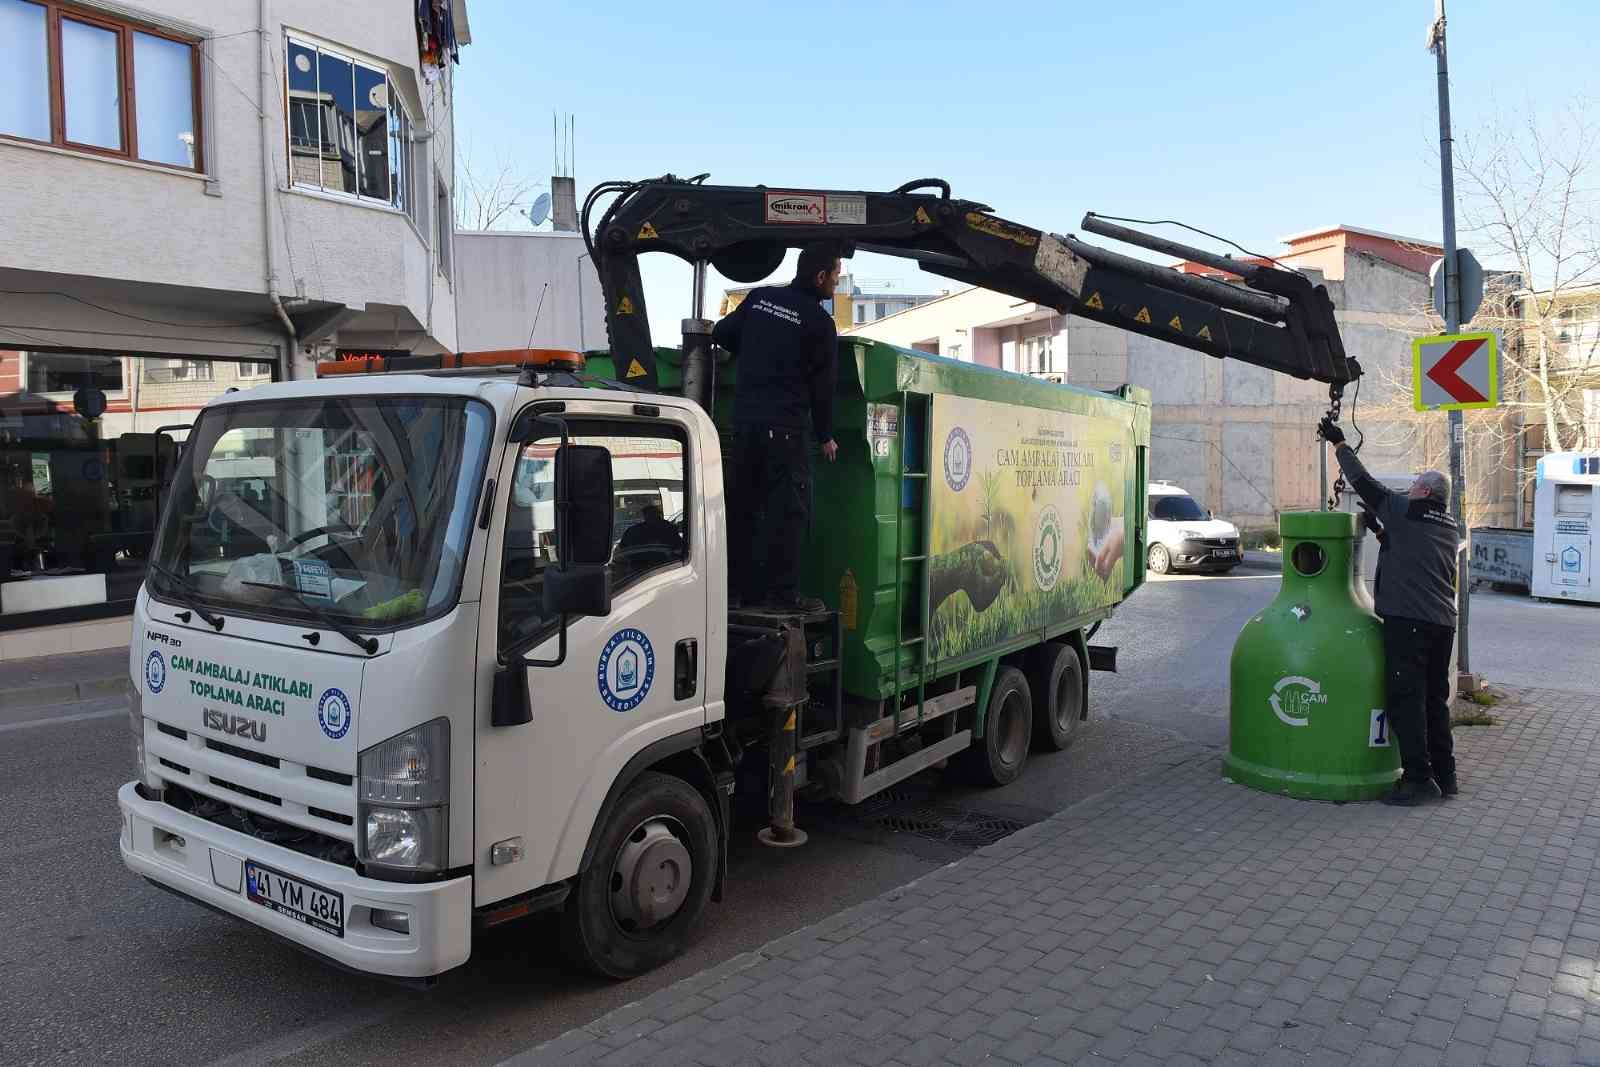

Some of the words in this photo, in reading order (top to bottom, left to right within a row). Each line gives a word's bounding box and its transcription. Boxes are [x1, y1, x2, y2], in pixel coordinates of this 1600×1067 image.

[774, 201, 809, 210] mikron
[996, 448, 1019, 466] CAM
[1019, 449, 1060, 469] AMBALAJ
[1015, 470, 1057, 488] TOPLAMA
[146, 631, 169, 645] NPR
[169, 638, 182, 648] 30
[170, 654, 194, 673] CAM
[195, 660, 250, 686] AMBALAJ
[252, 672, 313, 699] ATIKLARI
[189, 680, 244, 706] TOPLAMA
[246, 693, 285, 716] ARACI
[1300, 692, 1328, 705] CAM
[203, 708, 267, 742] ISUZU
[1374, 711, 1386, 745] 1
[257, 871, 271, 898] 41
[278, 878, 304, 910] YM
[310, 891, 340, 925] 484
